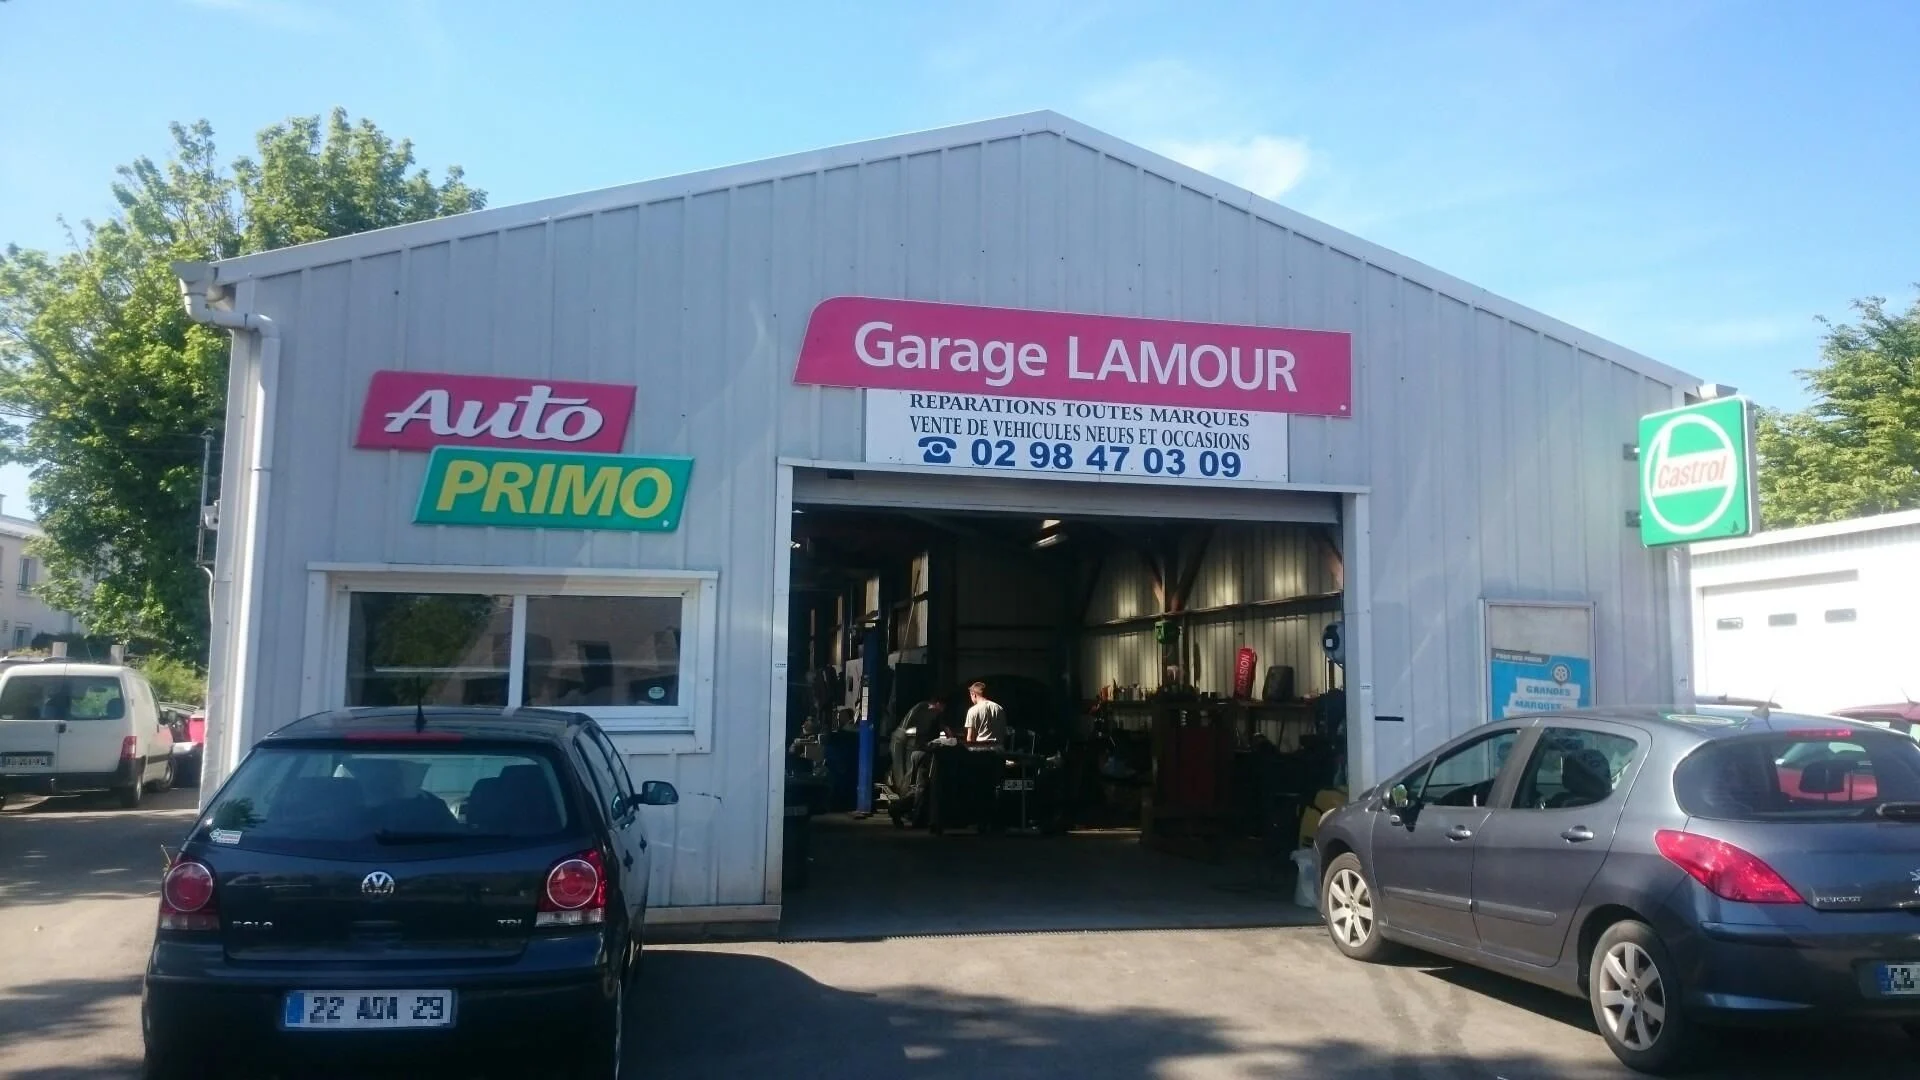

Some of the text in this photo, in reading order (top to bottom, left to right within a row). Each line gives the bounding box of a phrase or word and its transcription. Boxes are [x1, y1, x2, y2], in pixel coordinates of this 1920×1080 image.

[854, 321, 1298, 393] Garage LAMOUR
[384, 385, 603, 441] Auto
[910, 393, 1249, 428] REPARATIONS TOUTES MARQUES
[910, 415, 1250, 450] VENTE DE VEHICULES NEUFS ET OCCASIONS
[971, 438, 1241, 478] 02 98 47 03 09
[1657, 455, 1727, 491] Castrol
[436, 459, 672, 519] PRIMO
[1236, 653, 1250, 695] CCASION
